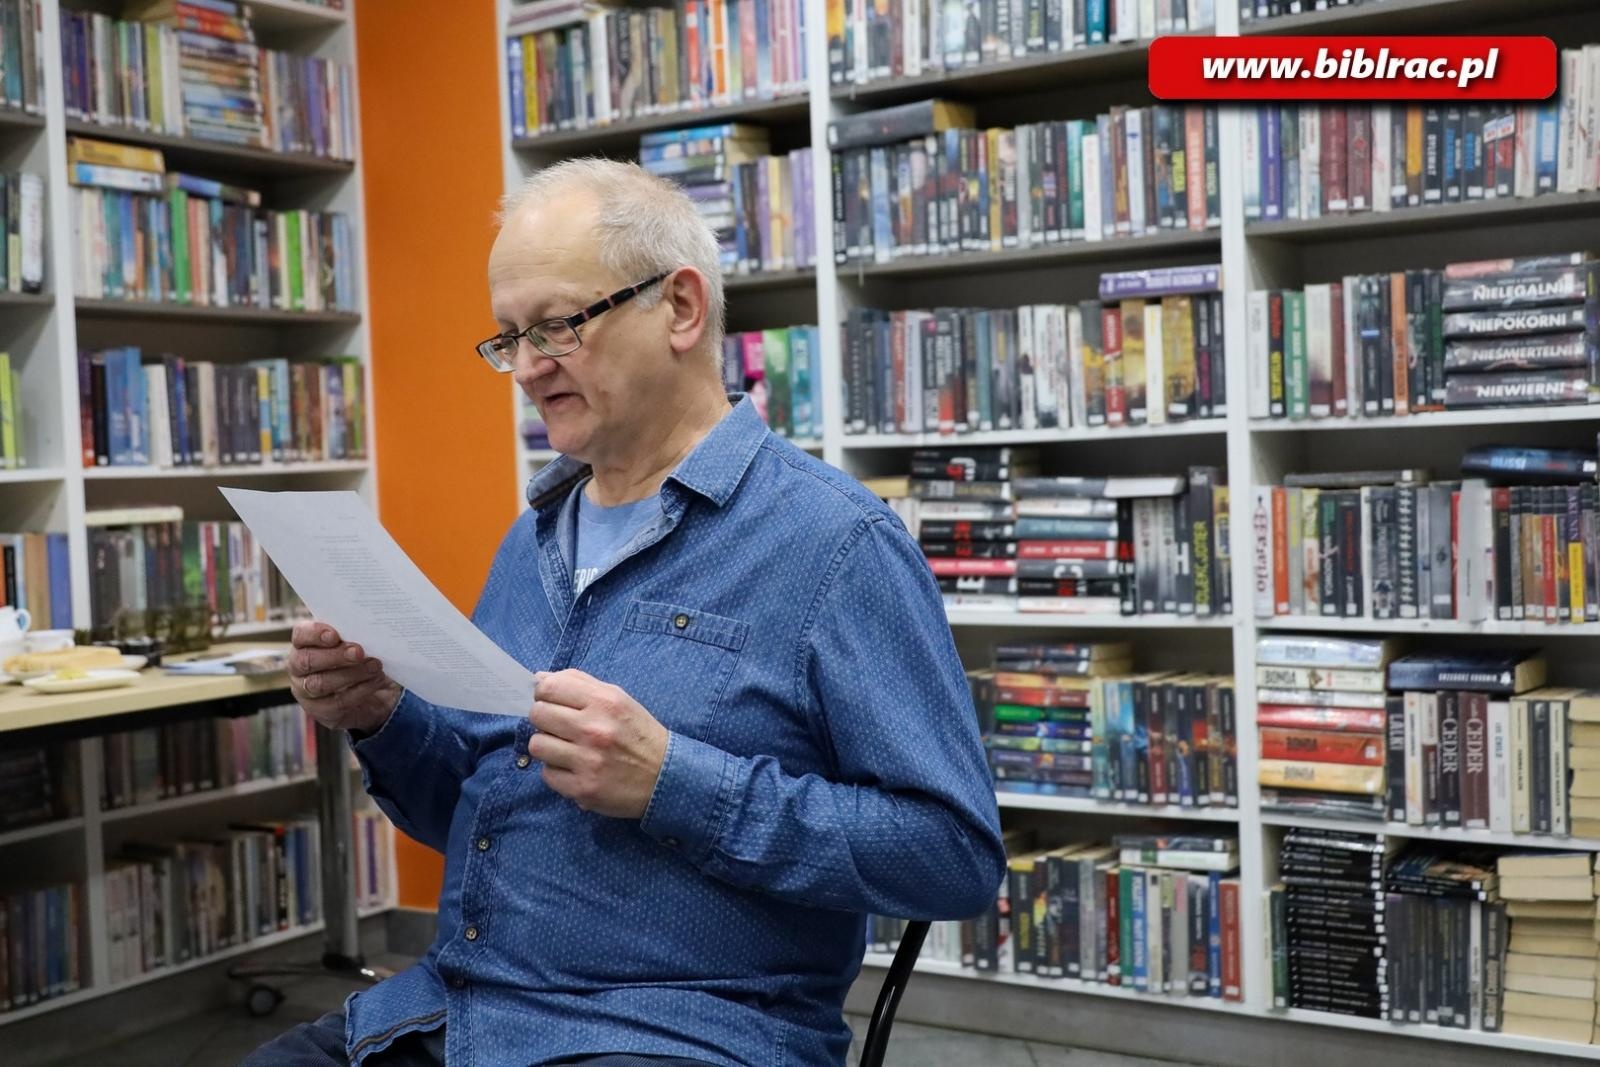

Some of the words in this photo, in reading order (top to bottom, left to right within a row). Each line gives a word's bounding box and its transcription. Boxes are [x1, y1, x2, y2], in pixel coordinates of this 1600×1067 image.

[1426, 134, 1437, 176] DYLEMAT
[1473, 280, 1566, 301] NIELEGALNI
[1469, 313, 1567, 333] NIEPOKORNI
[1476, 382, 1565, 398] NIEWIERNI
[1193, 520, 1209, 603] OLEKCJONER
[1265, 670, 1296, 685] BONDA
[1389, 713, 1404, 751] LALKI
[1441, 718, 1458, 774] CEDER
[1466, 718, 1484, 774] CEDER
